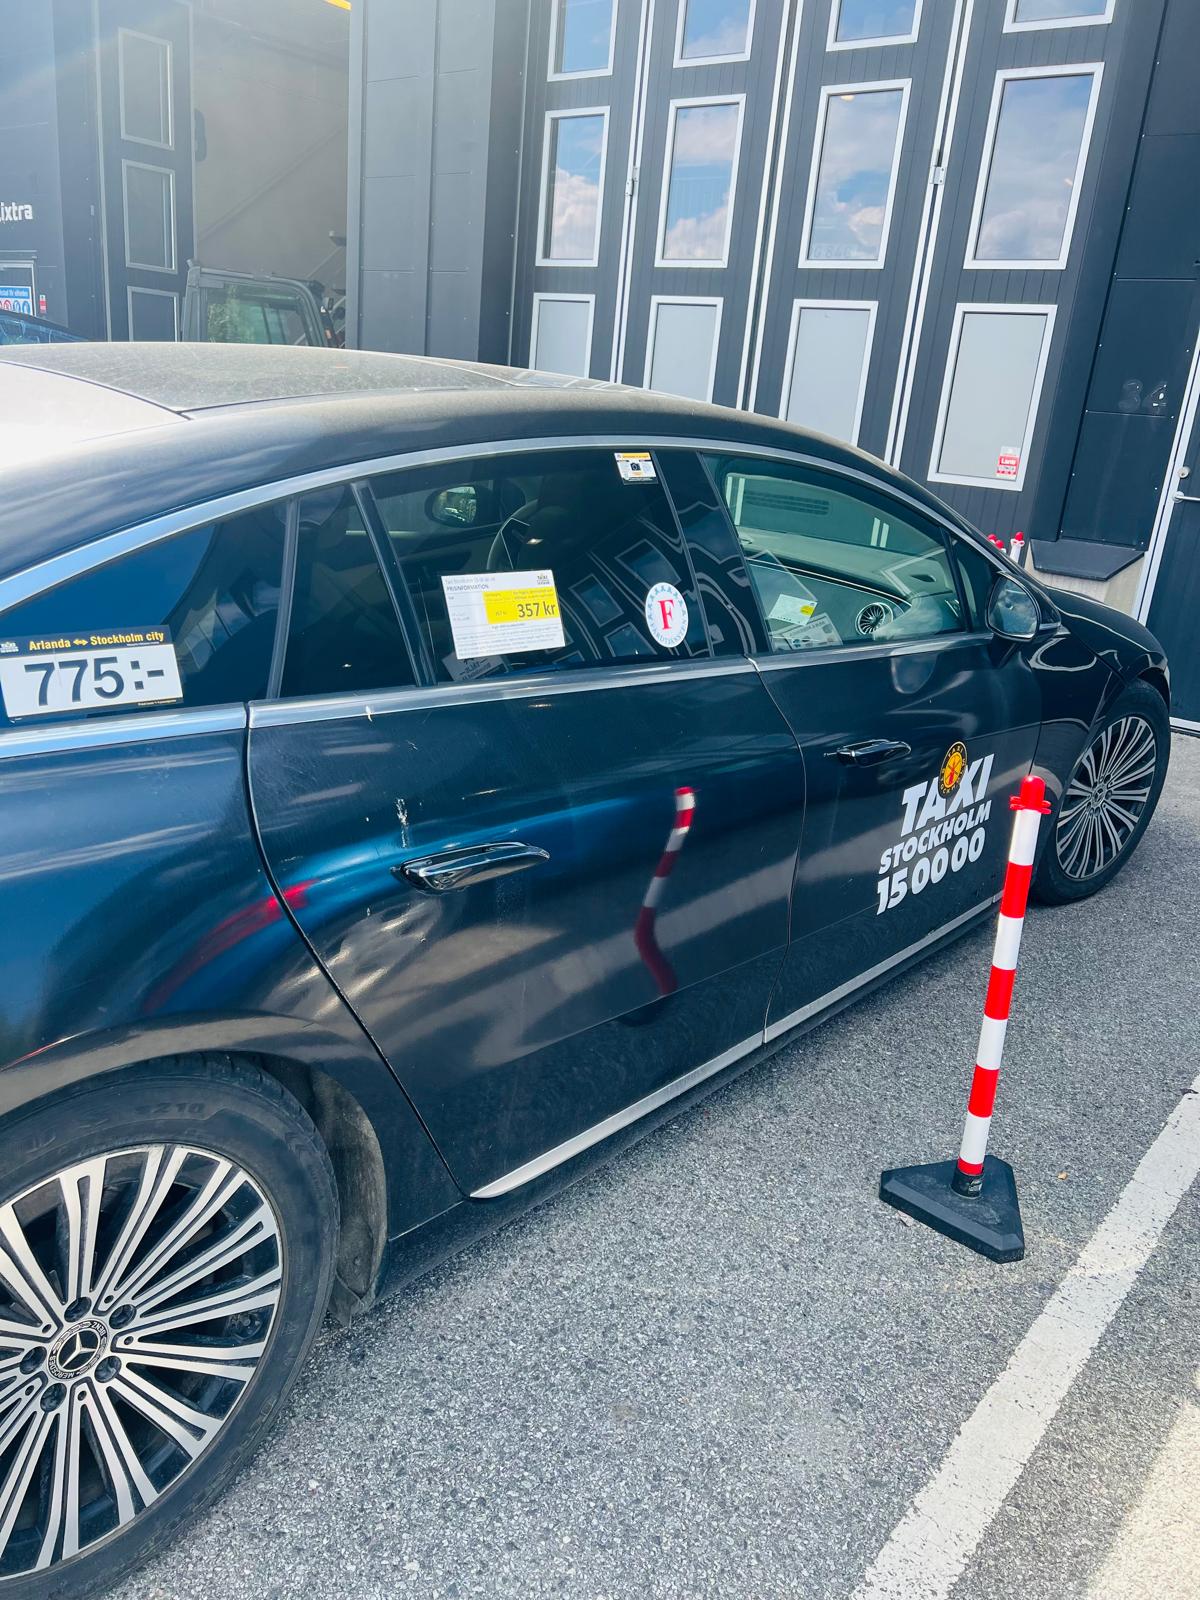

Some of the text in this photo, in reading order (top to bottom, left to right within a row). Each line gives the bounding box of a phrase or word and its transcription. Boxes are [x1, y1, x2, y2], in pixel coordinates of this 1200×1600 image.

[0, 201, 33, 222] ixtra
[517, 603, 540, 618] 357
[543, 601, 556, 616] kr
[657, 599, 675, 630] F
[29, 639, 71, 651] Arlanda
[90, 634, 144, 646] Stockholm
[146, 631, 164, 642] city
[24, 656, 164, 706] 775:-
[901, 754, 995, 838] TAXI
[878, 800, 992, 875] STOCKHOLM
[91, 1321, 107, 1337] BENZ
[49, 1355, 75, 1379] MERCEDES
